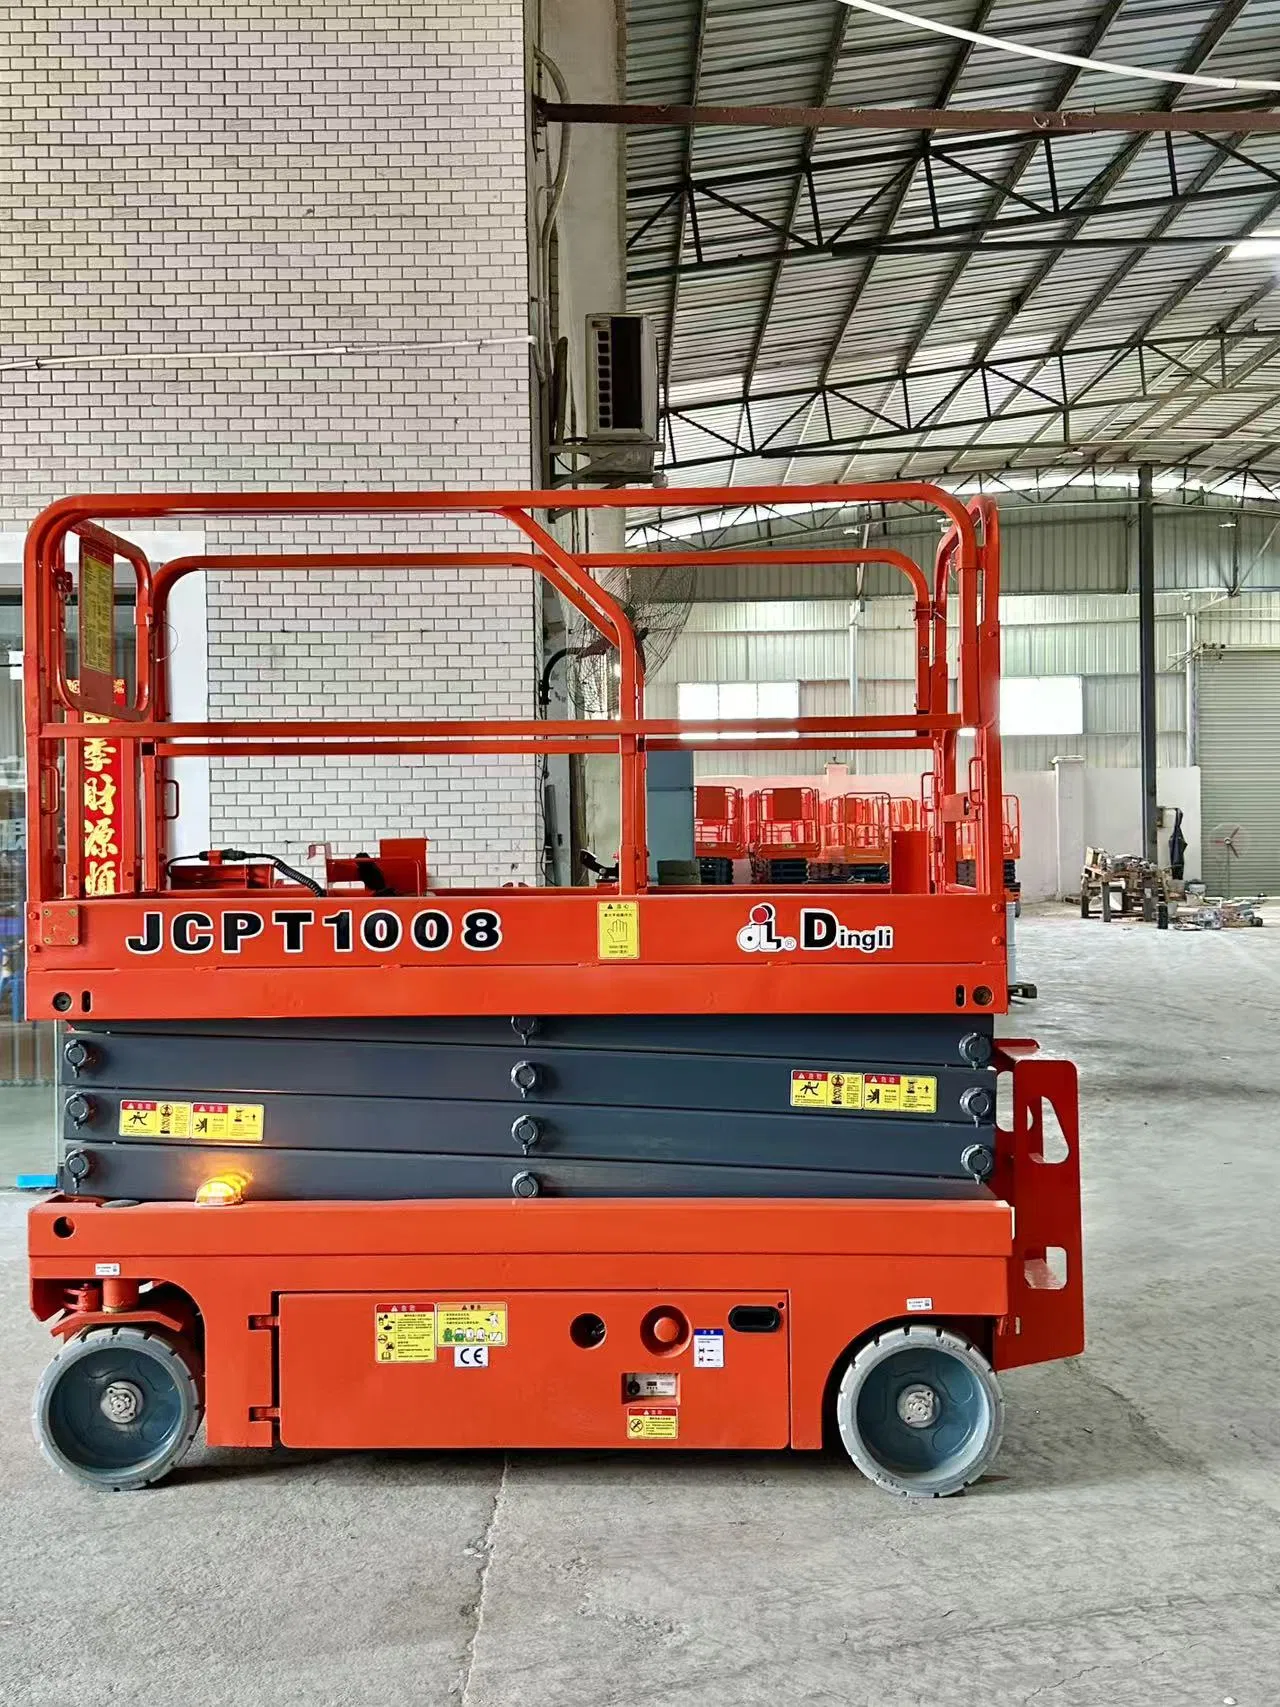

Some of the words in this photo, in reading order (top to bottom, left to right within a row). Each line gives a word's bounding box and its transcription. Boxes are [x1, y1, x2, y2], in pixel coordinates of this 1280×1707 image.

[125, 909, 502, 955] JCPT1008
[801, 908, 893, 953] Dingli
[460, 1347, 483, 1364] CE
